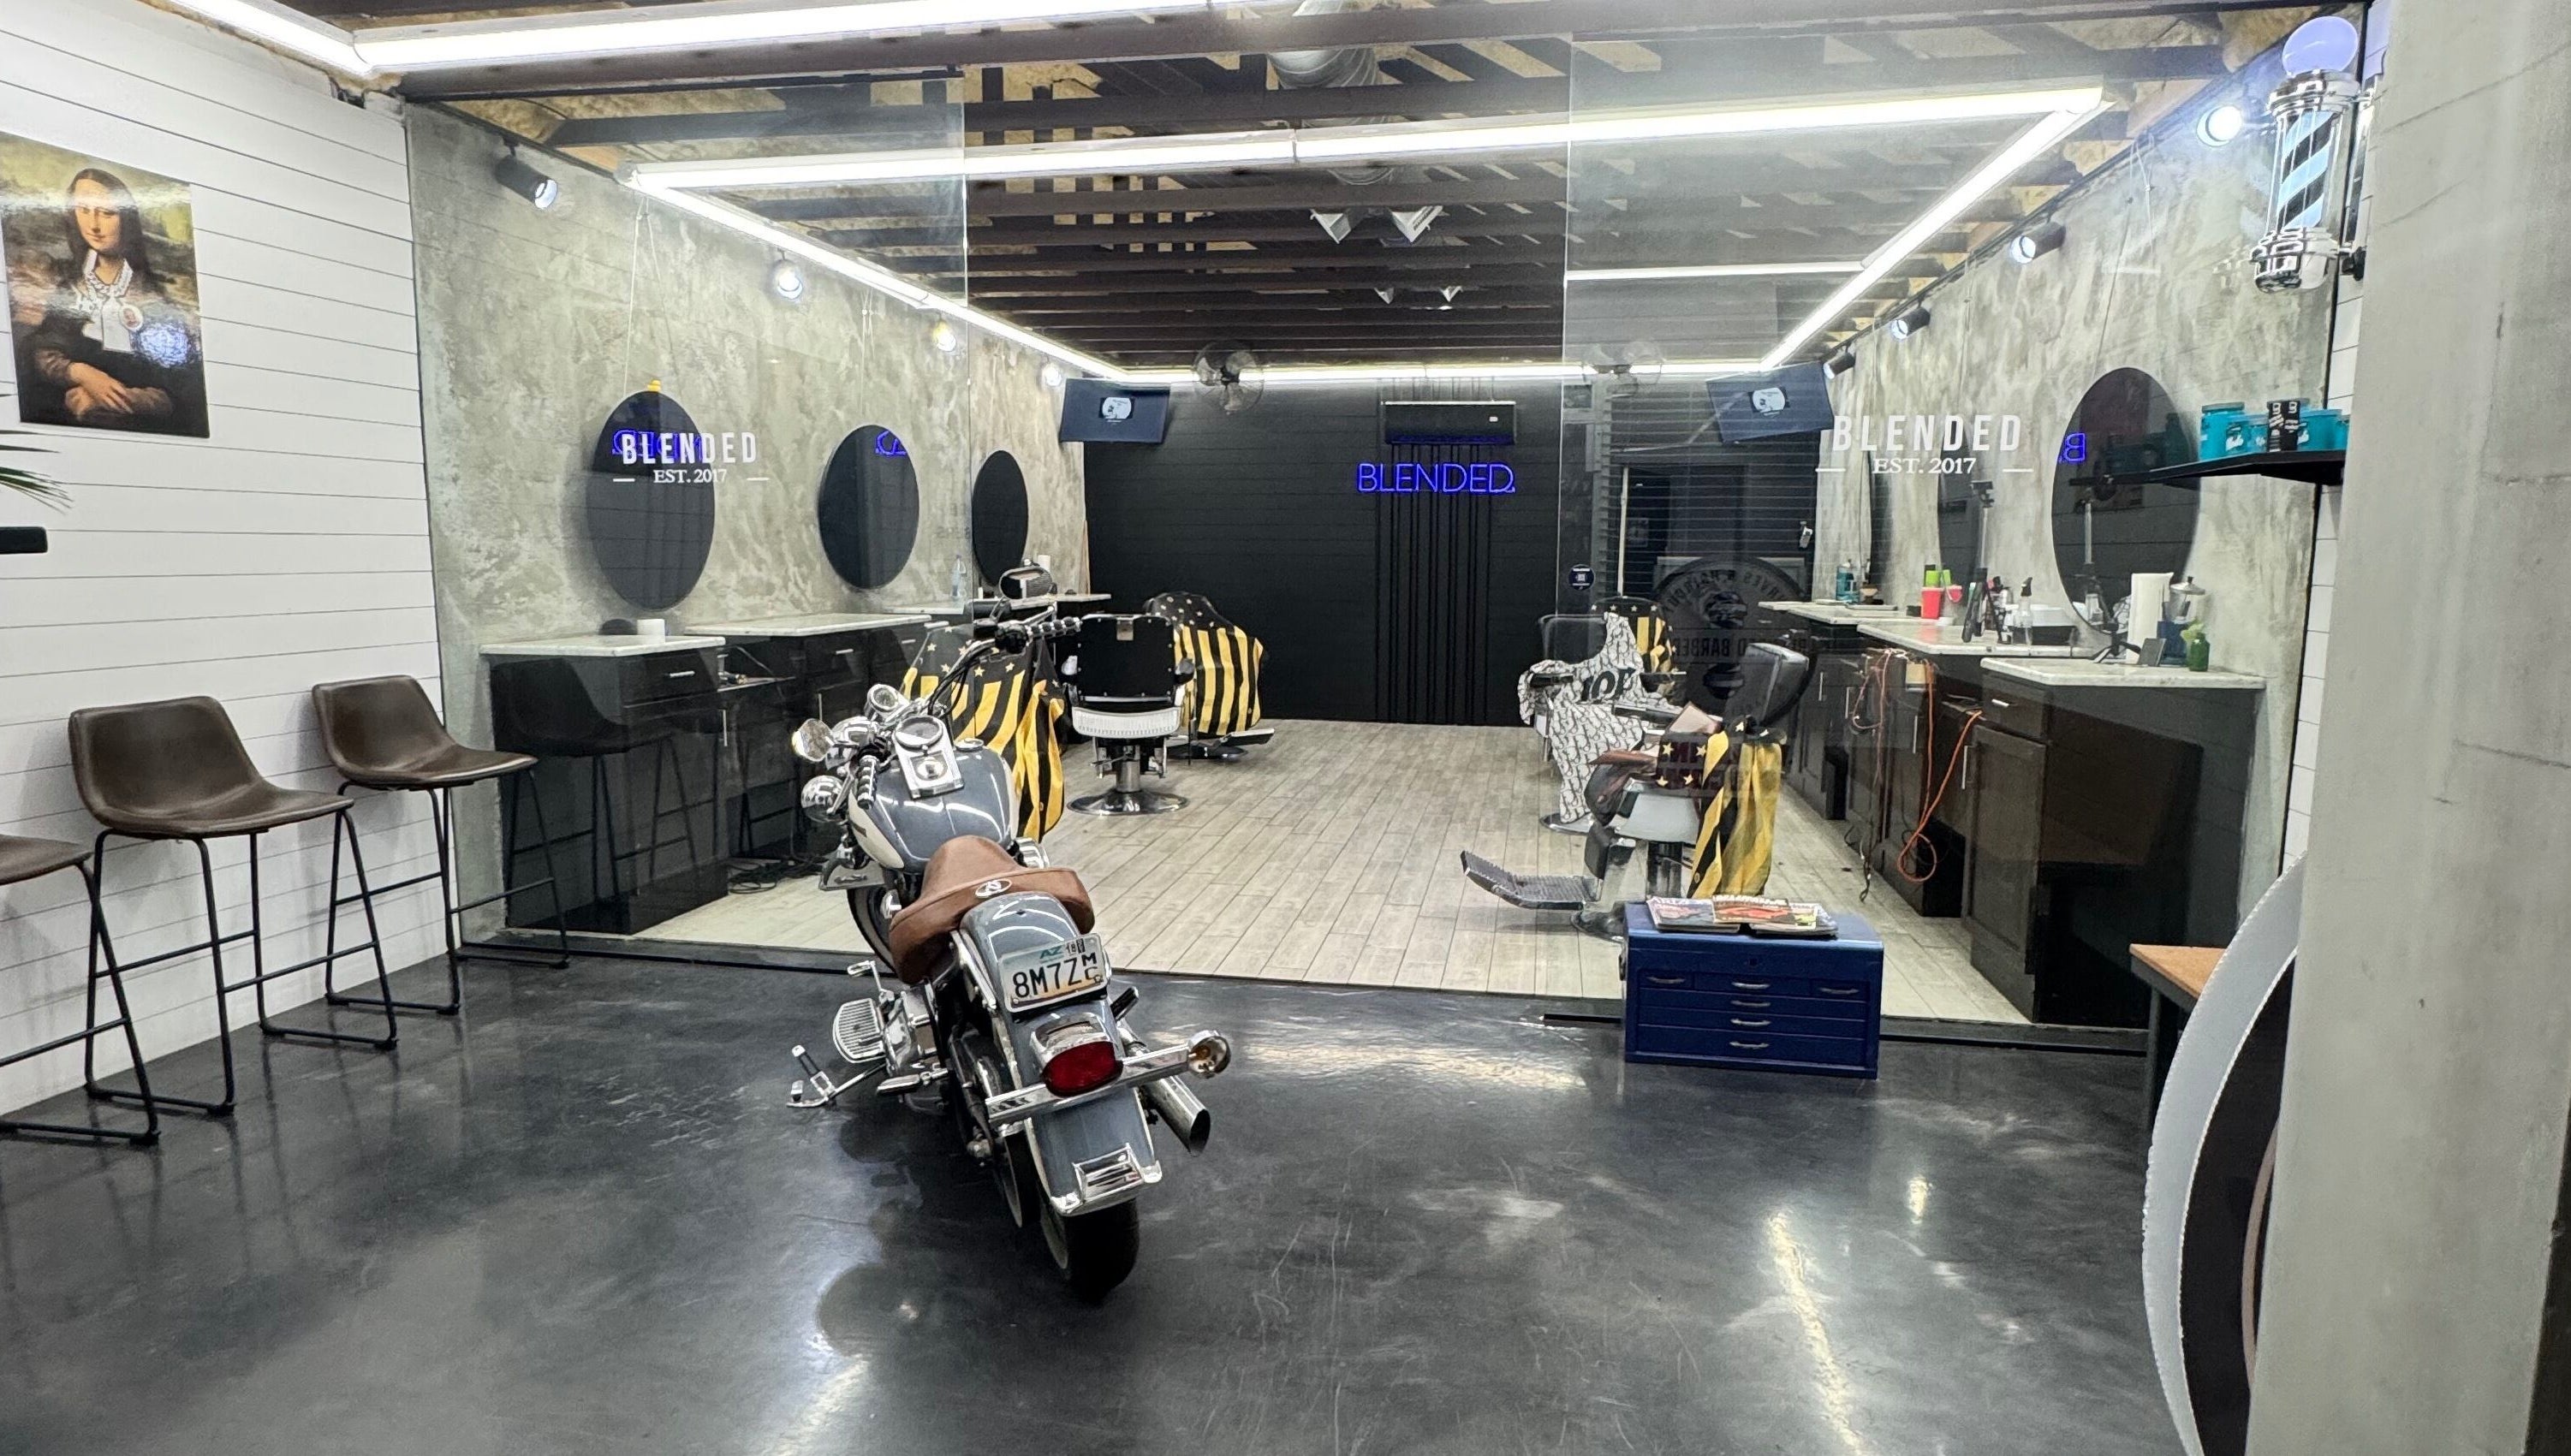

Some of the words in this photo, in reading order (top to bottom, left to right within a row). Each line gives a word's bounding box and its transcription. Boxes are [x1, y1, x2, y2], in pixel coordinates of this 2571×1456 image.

[1833, 414, 2021, 451] BLENDED
[622, 431, 757, 465] BLENDED
[653, 469, 692, 484] EST.
[694, 468, 728, 484] 2017
[1872, 458, 1924, 474] EST.
[1928, 457, 1977, 474] 2017
[1039, 945, 1063, 959] AZ
[1012, 957, 1082, 998] 8M7Z
